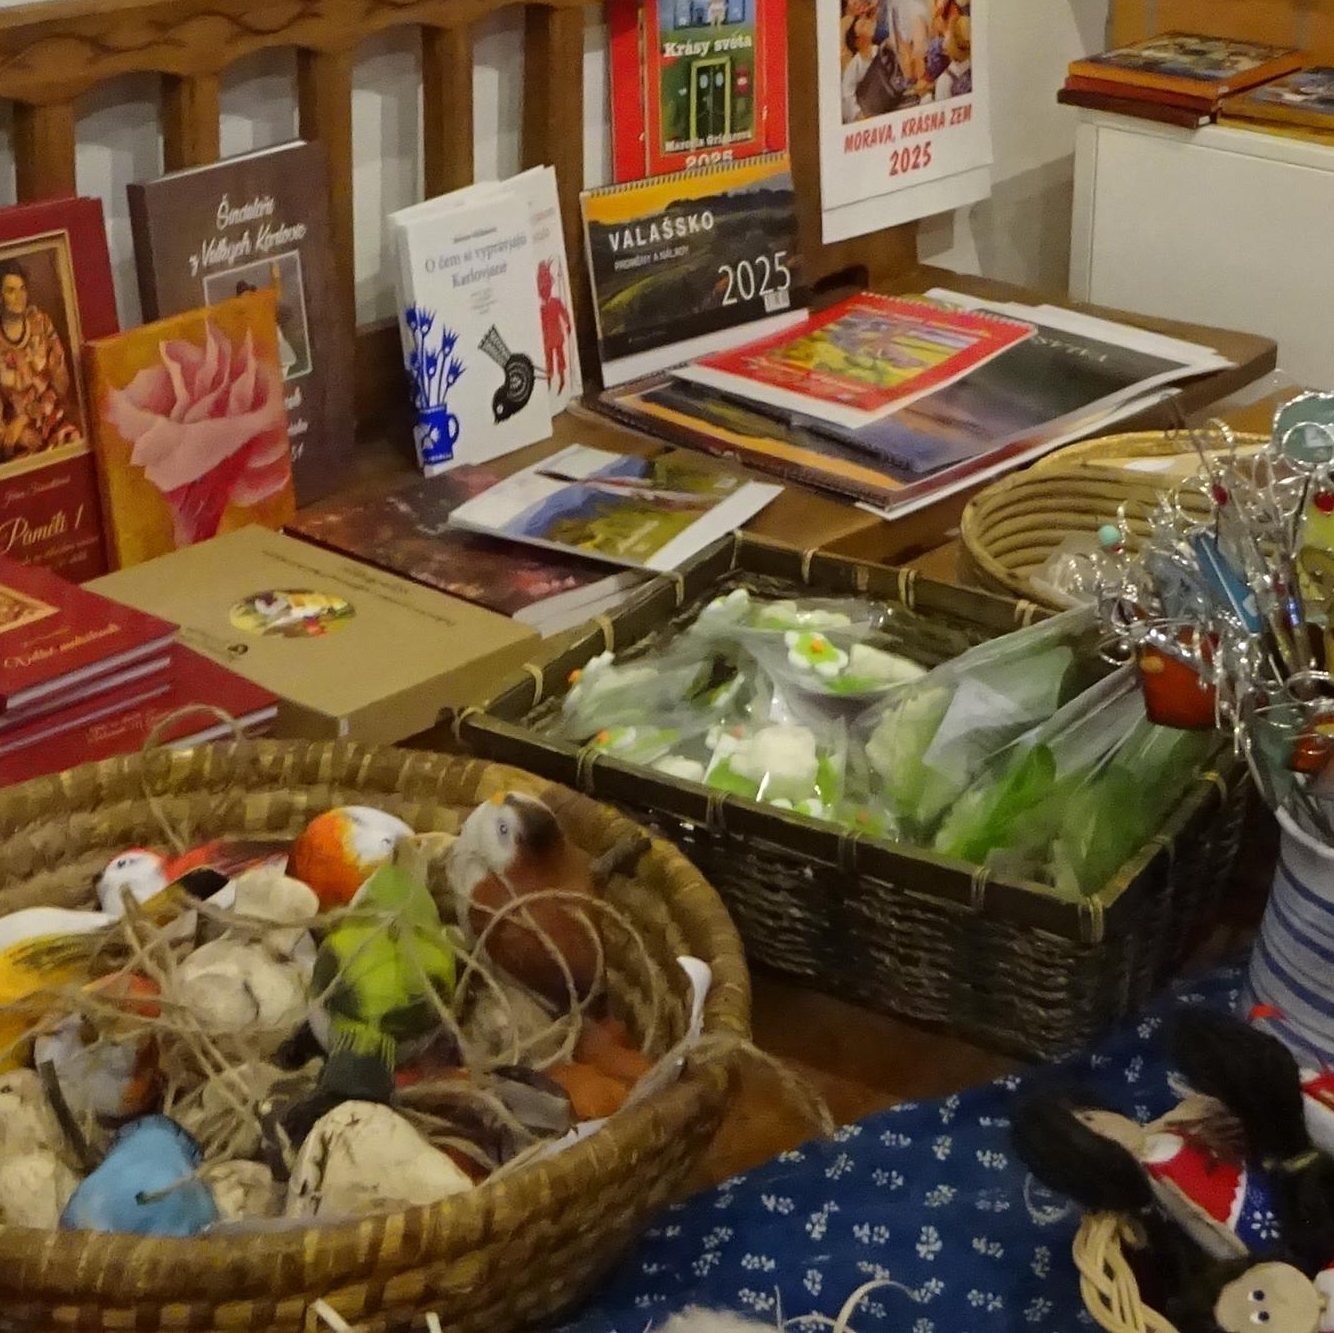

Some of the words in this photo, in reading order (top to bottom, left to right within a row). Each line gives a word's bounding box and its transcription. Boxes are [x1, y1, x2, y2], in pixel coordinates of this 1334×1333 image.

[662, 37, 709, 59] Krásy
[714, 29, 752, 54] světa
[844, 125, 895, 153] MORAVA,
[950, 104, 972, 125] ZEM
[889, 141, 932, 176] 2025
[608, 210, 714, 252] VALAŠSKO
[718, 251, 791, 307] 2025
